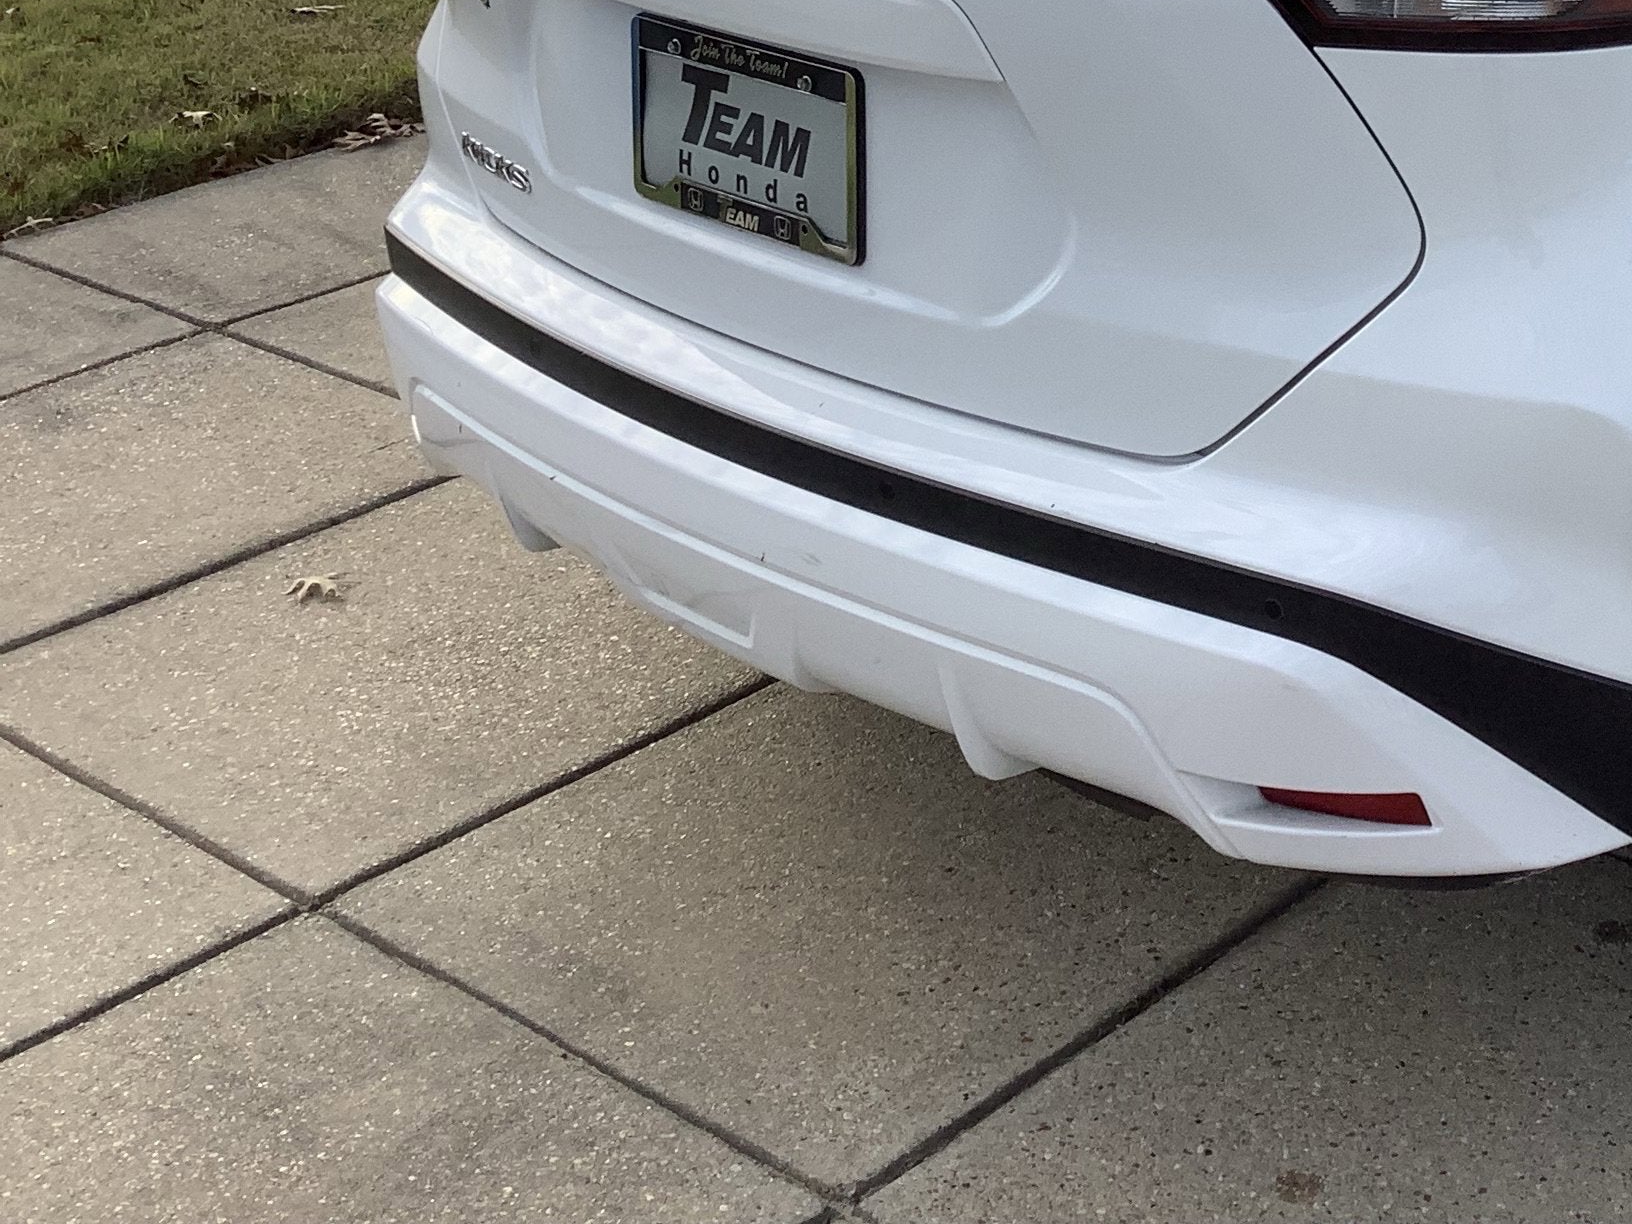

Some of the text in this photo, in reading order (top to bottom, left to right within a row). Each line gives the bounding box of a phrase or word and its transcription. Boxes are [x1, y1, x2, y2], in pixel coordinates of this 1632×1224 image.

[690, 36, 789, 79] Join The Team!
[681, 63, 811, 178] TEAM
[461, 131, 532, 194] KICKS
[678, 149, 808, 213] Honda
[717, 194, 760, 232] TEAM
